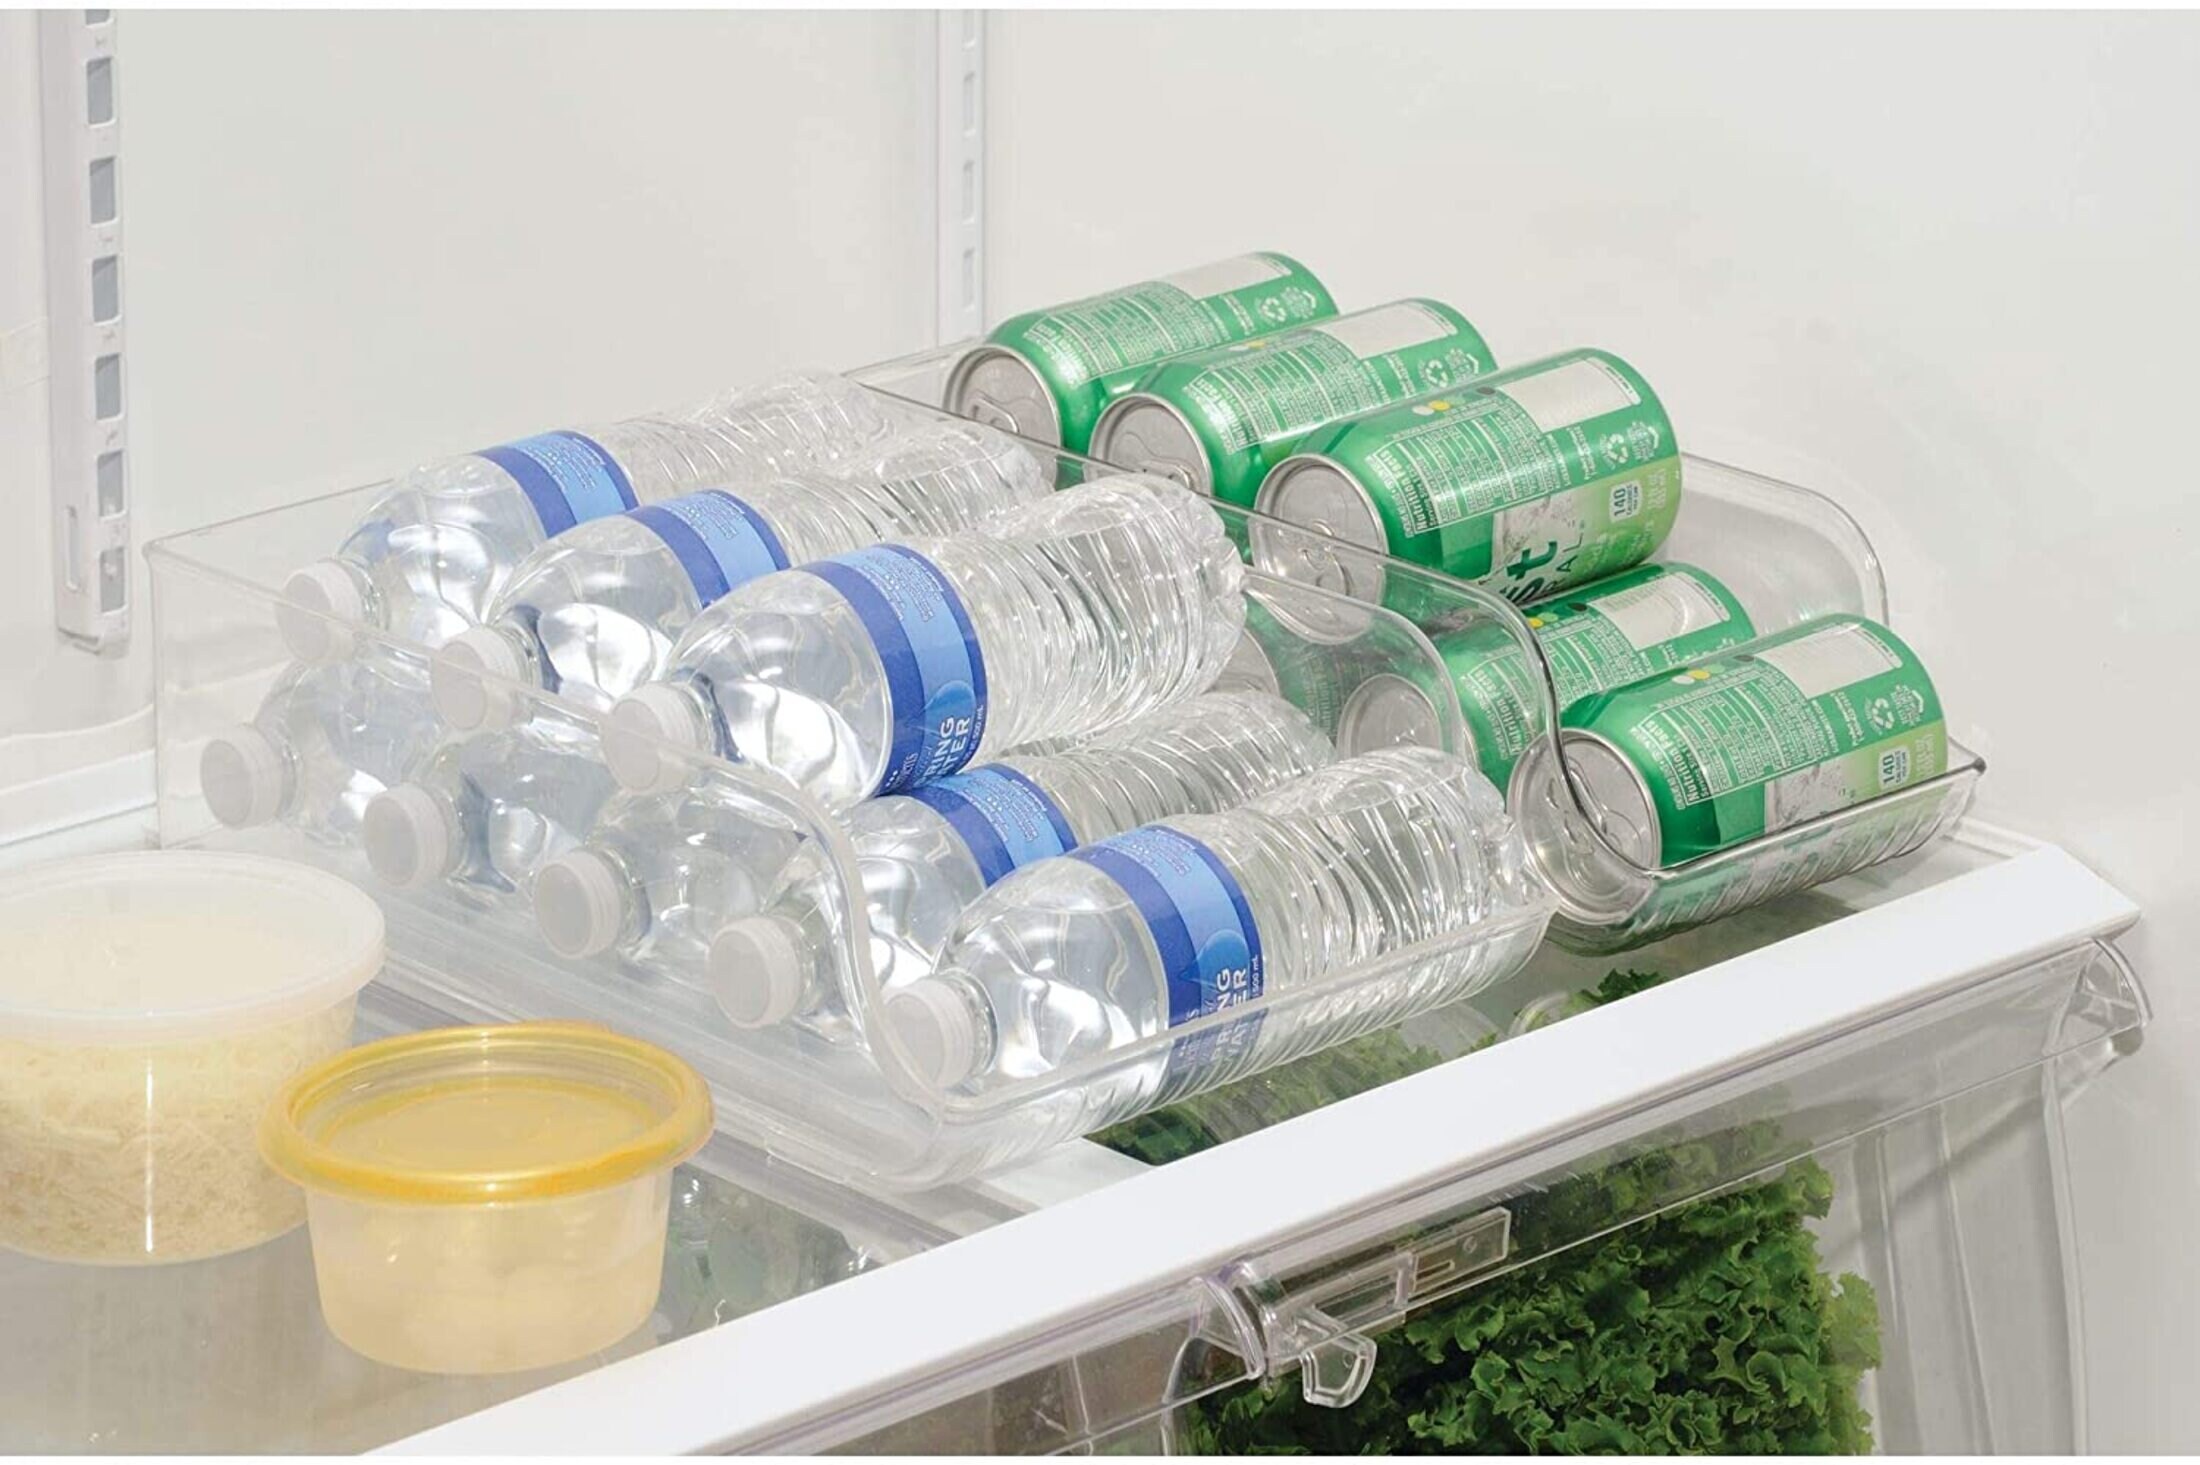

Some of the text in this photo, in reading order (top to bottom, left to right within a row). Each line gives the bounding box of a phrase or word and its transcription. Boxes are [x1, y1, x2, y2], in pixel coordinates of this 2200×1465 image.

[1400, 476, 1428, 531] Nutrition
[1613, 487, 1626, 517] 140
[1644, 719, 1673, 749] Facts
[1668, 746, 1699, 802] Nutrition
[1882, 754, 1895, 784] 140
[1252, 972, 1261, 993] 500
